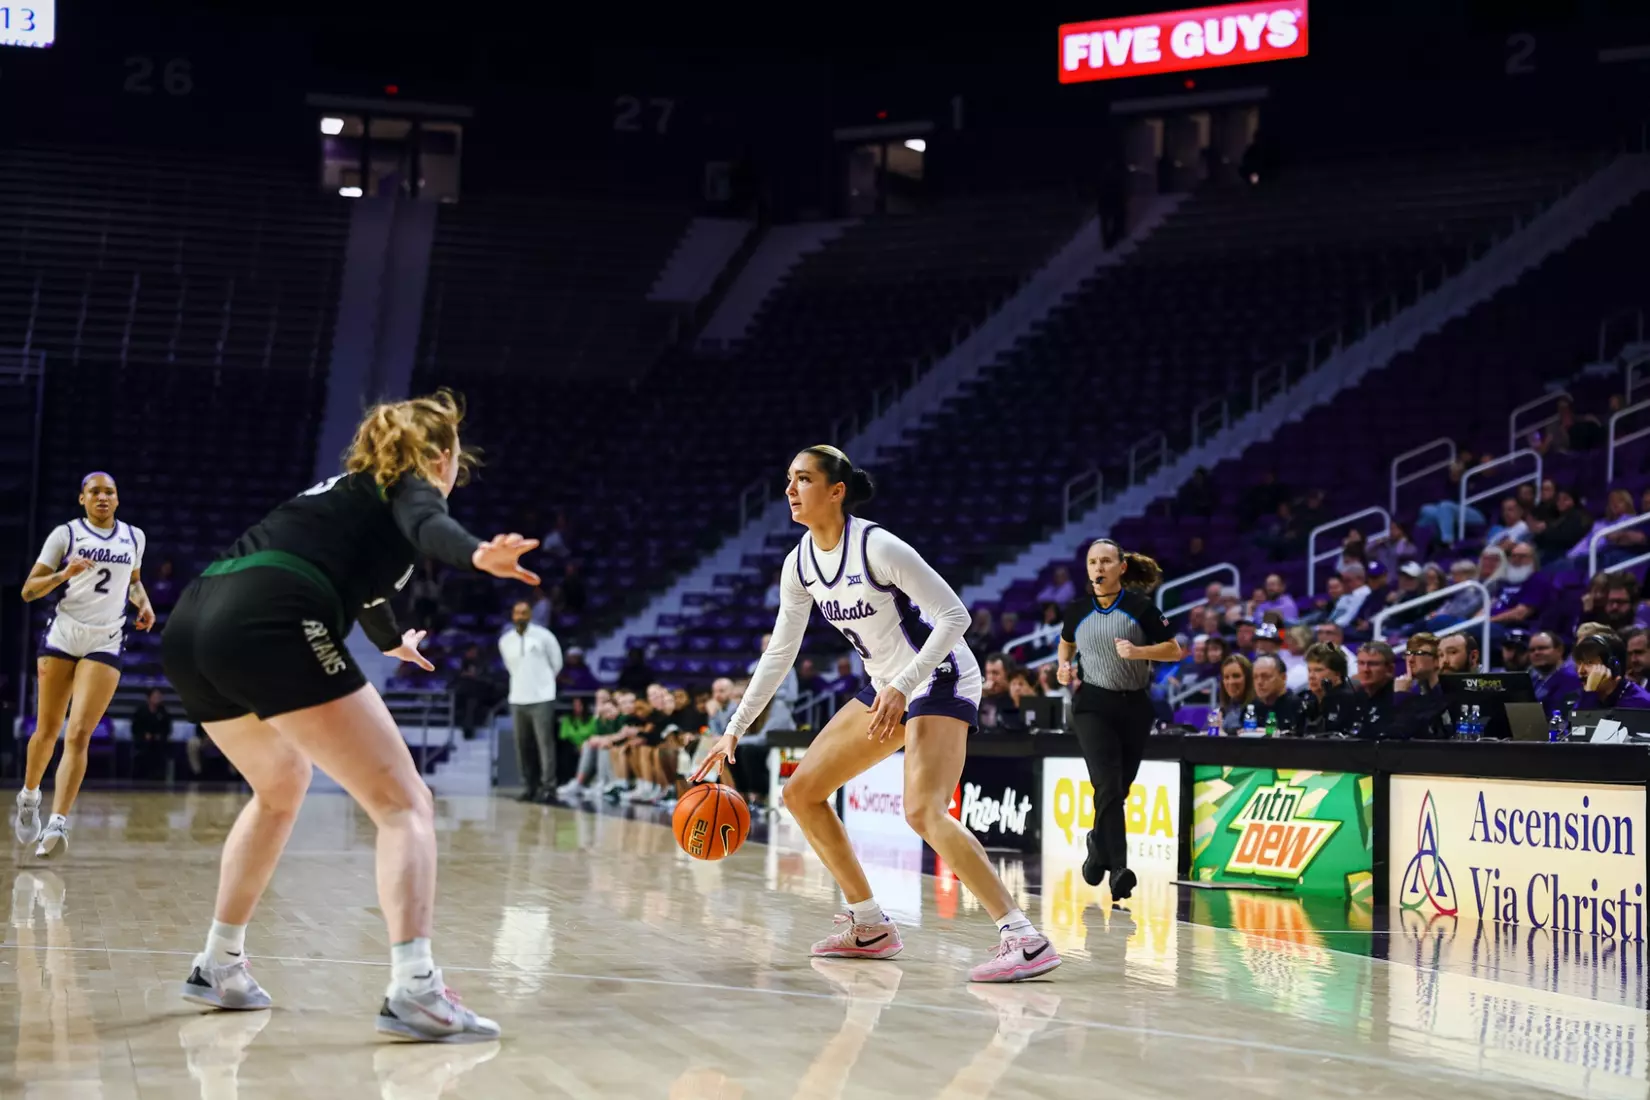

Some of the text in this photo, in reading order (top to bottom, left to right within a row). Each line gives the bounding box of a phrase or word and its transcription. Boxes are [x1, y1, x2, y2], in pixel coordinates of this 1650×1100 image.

[1063, 9, 1299, 71] FIVE GUYS
[1505, 32, 1537, 75] 2
[123, 56, 194, 96] 26
[613, 94, 675, 134] 27
[78, 547, 131, 564] Wildcats
[94, 568, 112, 594] 2
[819, 598, 878, 621] ildcats
[1000, 786, 1033, 836] Hut
[1053, 778, 1174, 845] QDBA
[1469, 791, 1636, 856] Ascension
[1469, 866, 1645, 943] Via Christi
